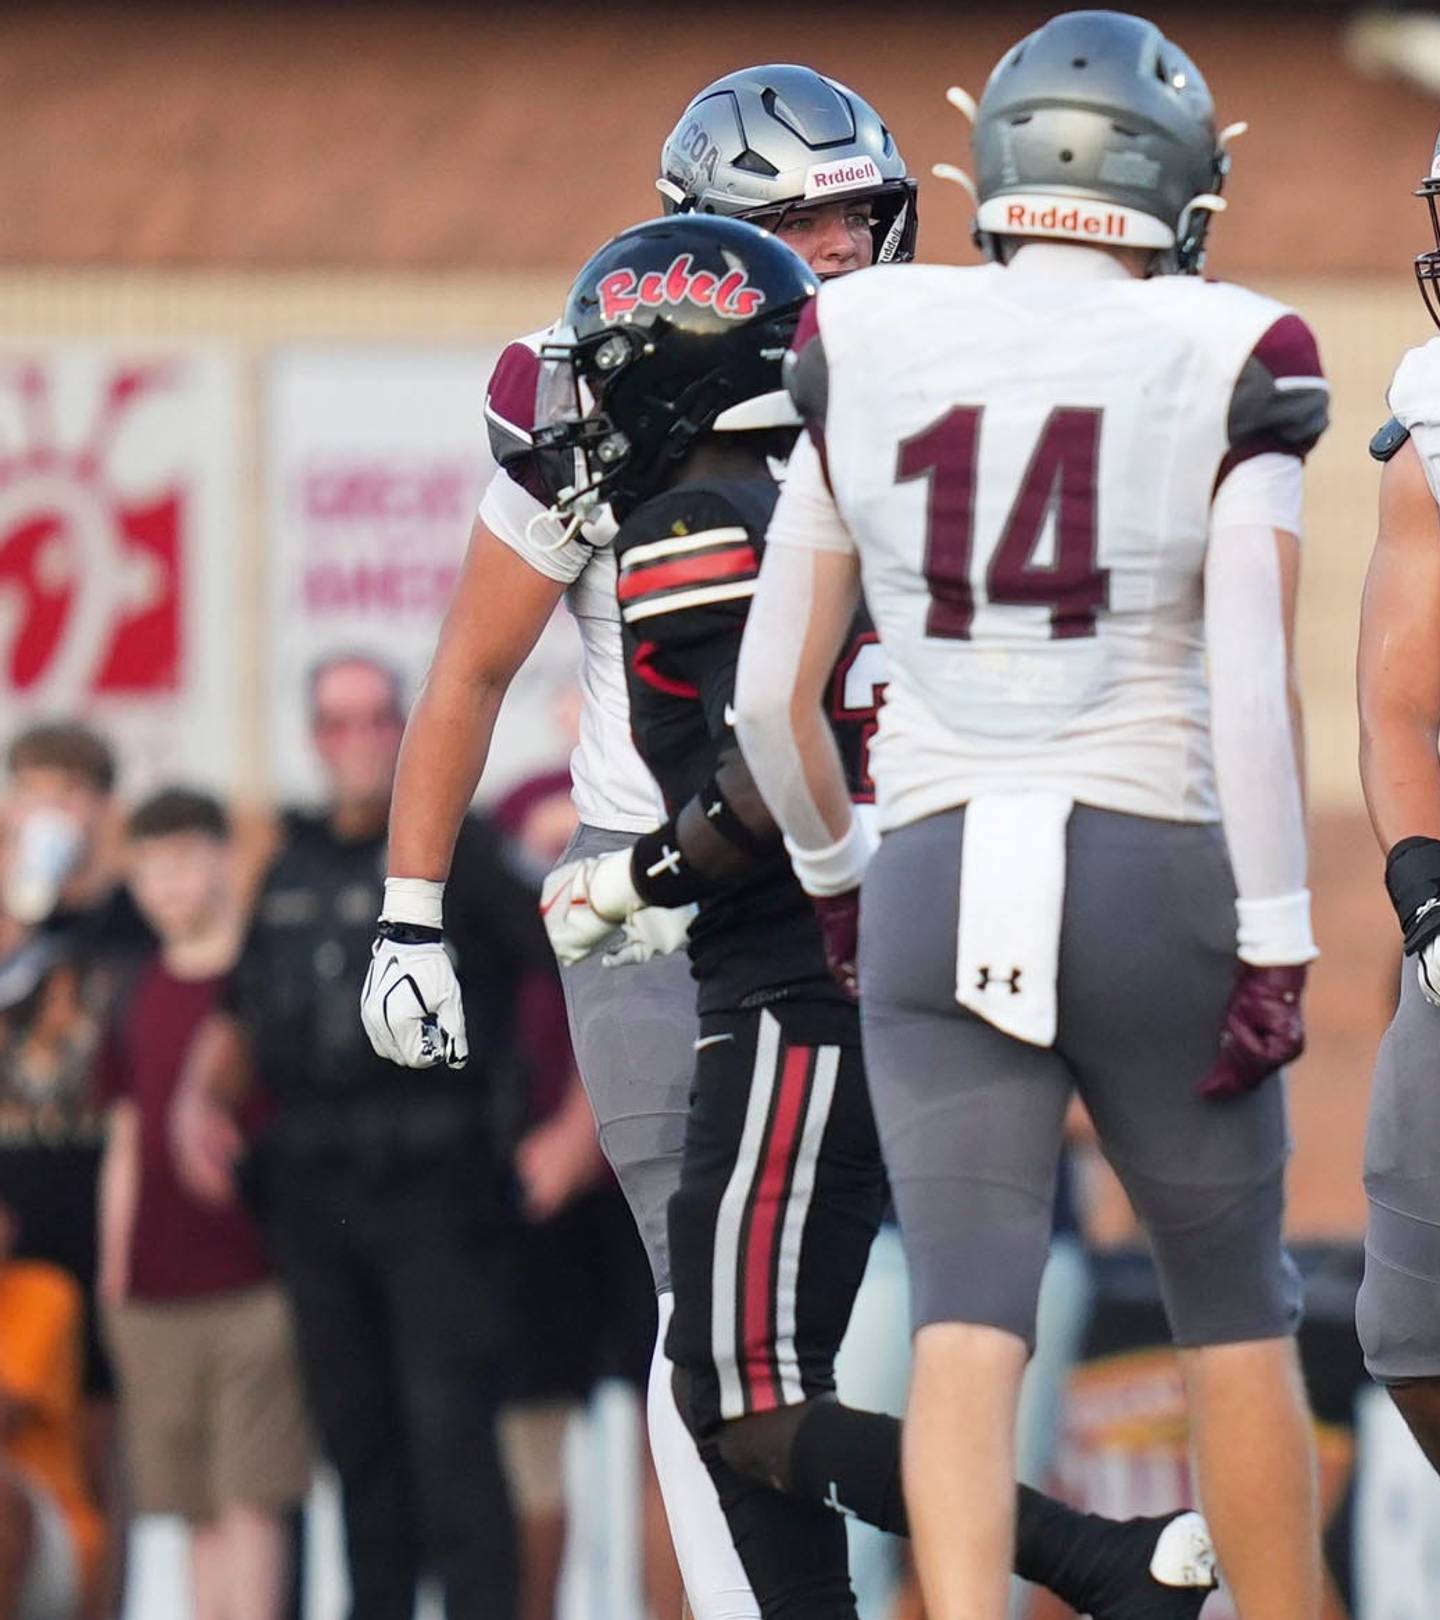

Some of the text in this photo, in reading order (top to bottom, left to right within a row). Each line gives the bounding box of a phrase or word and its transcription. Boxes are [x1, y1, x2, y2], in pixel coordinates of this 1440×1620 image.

[681, 121, 719, 183] COA
[814, 164, 876, 188] Riddell
[1008, 205, 1127, 238] Riddell
[596, 253, 766, 327] Rebels
[894, 404, 1111, 640] 14
